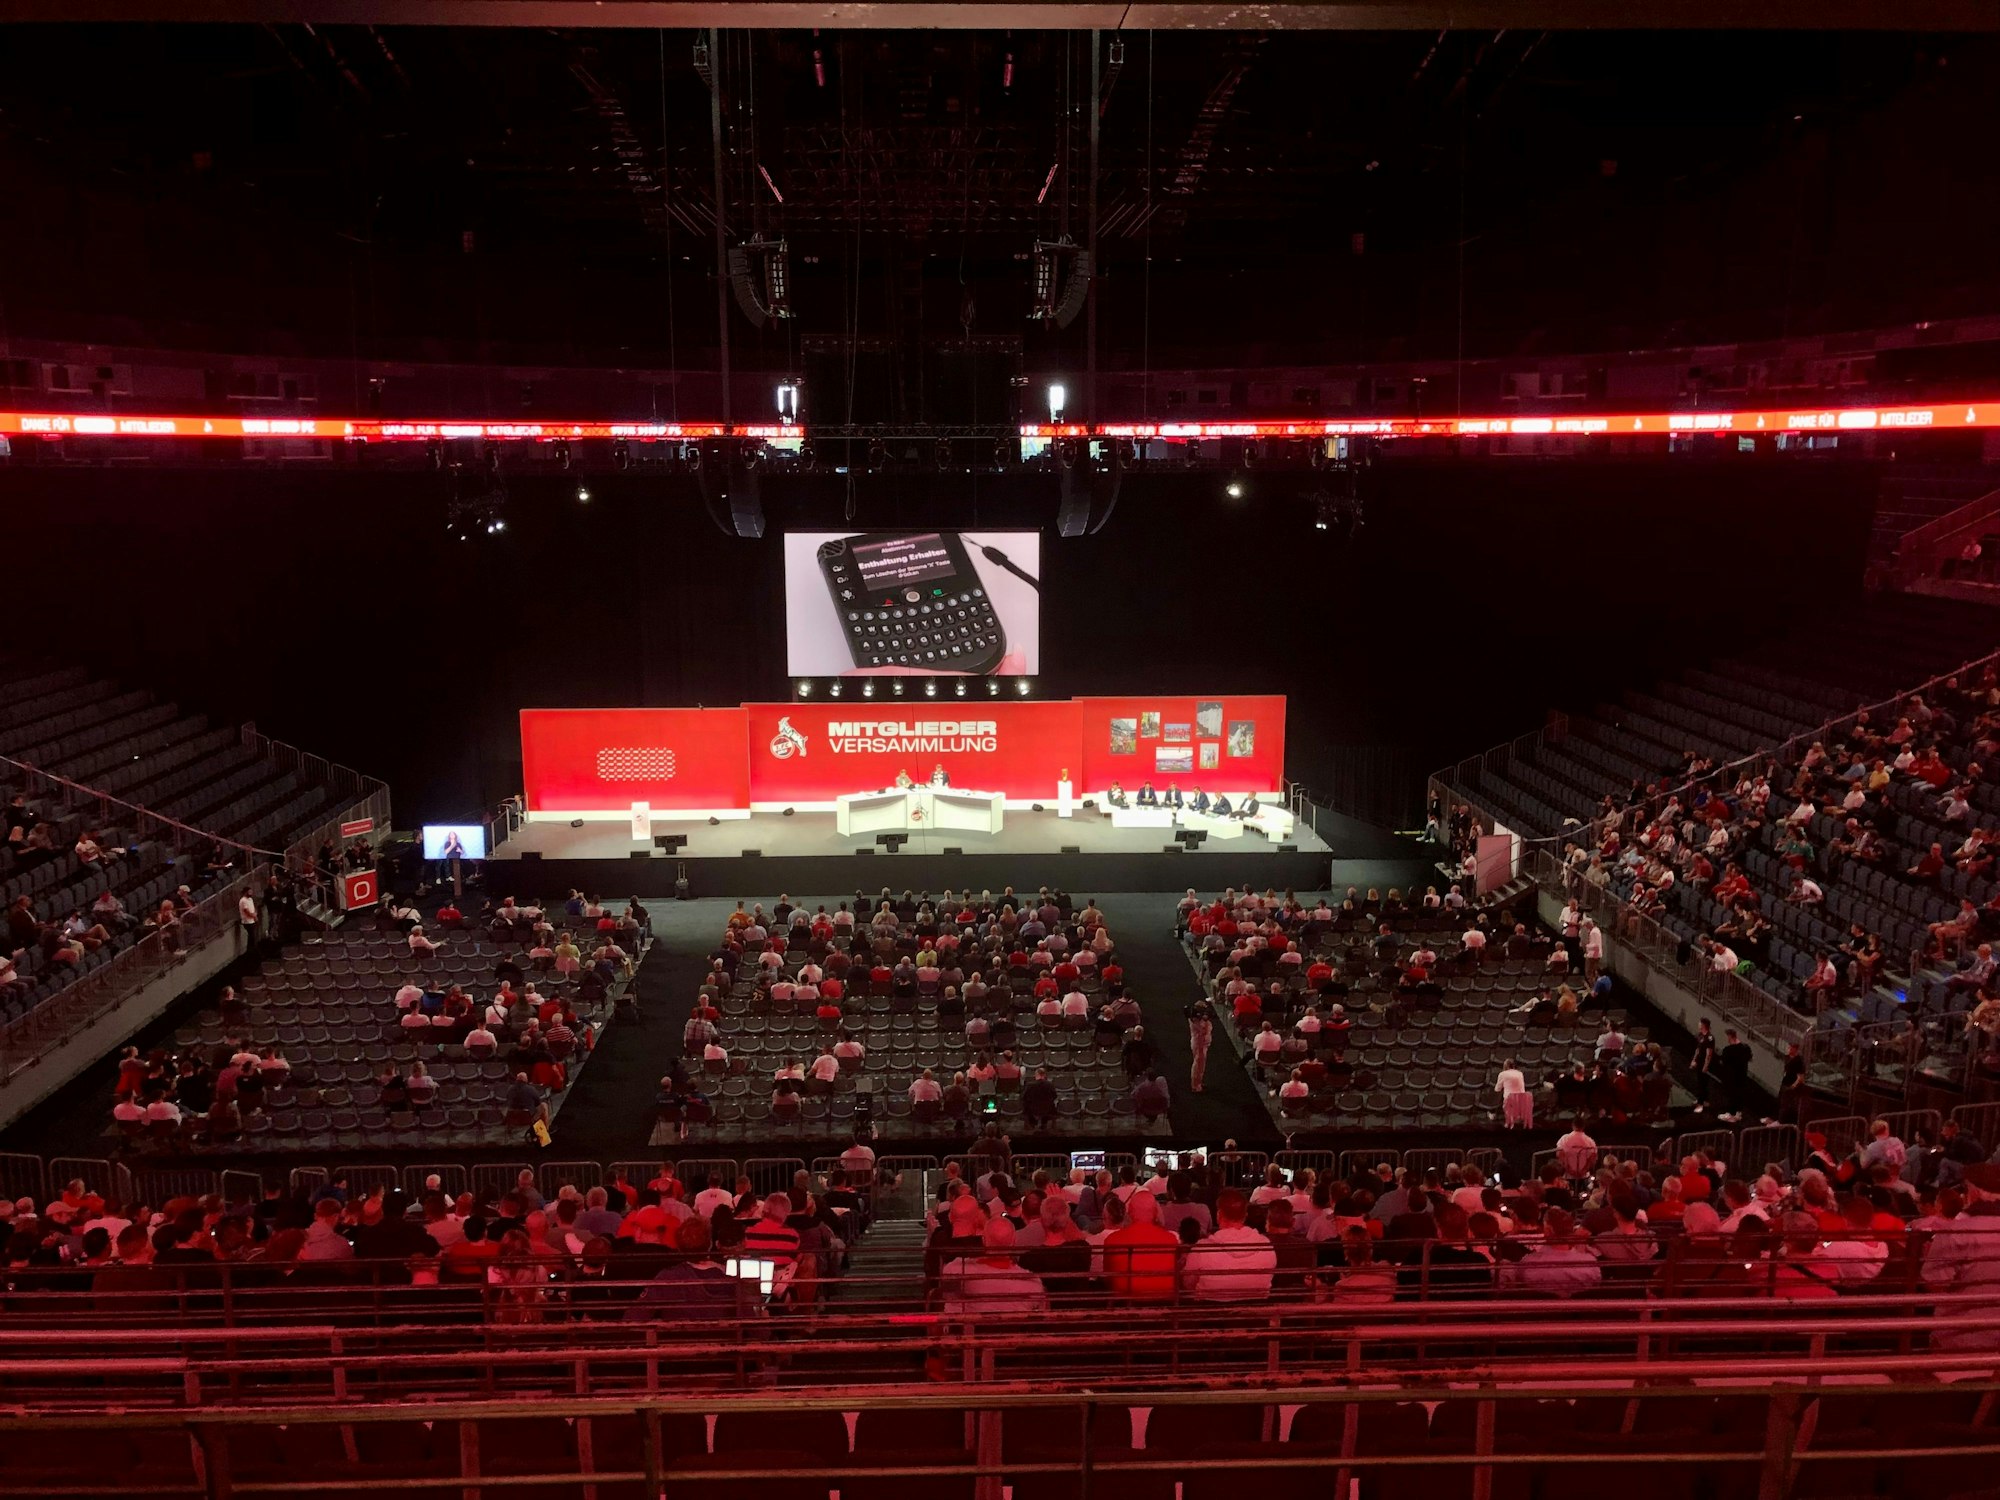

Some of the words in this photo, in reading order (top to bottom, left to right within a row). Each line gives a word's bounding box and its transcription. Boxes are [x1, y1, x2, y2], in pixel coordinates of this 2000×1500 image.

[1880, 412, 1932, 425] MITGLIEDER
[858, 556, 908, 569] Enthaltung
[909, 549, 947, 561] Erhalten
[828, 721, 997, 736] MITGLIEDER
[829, 737, 997, 753] VERSAMMLUNG
